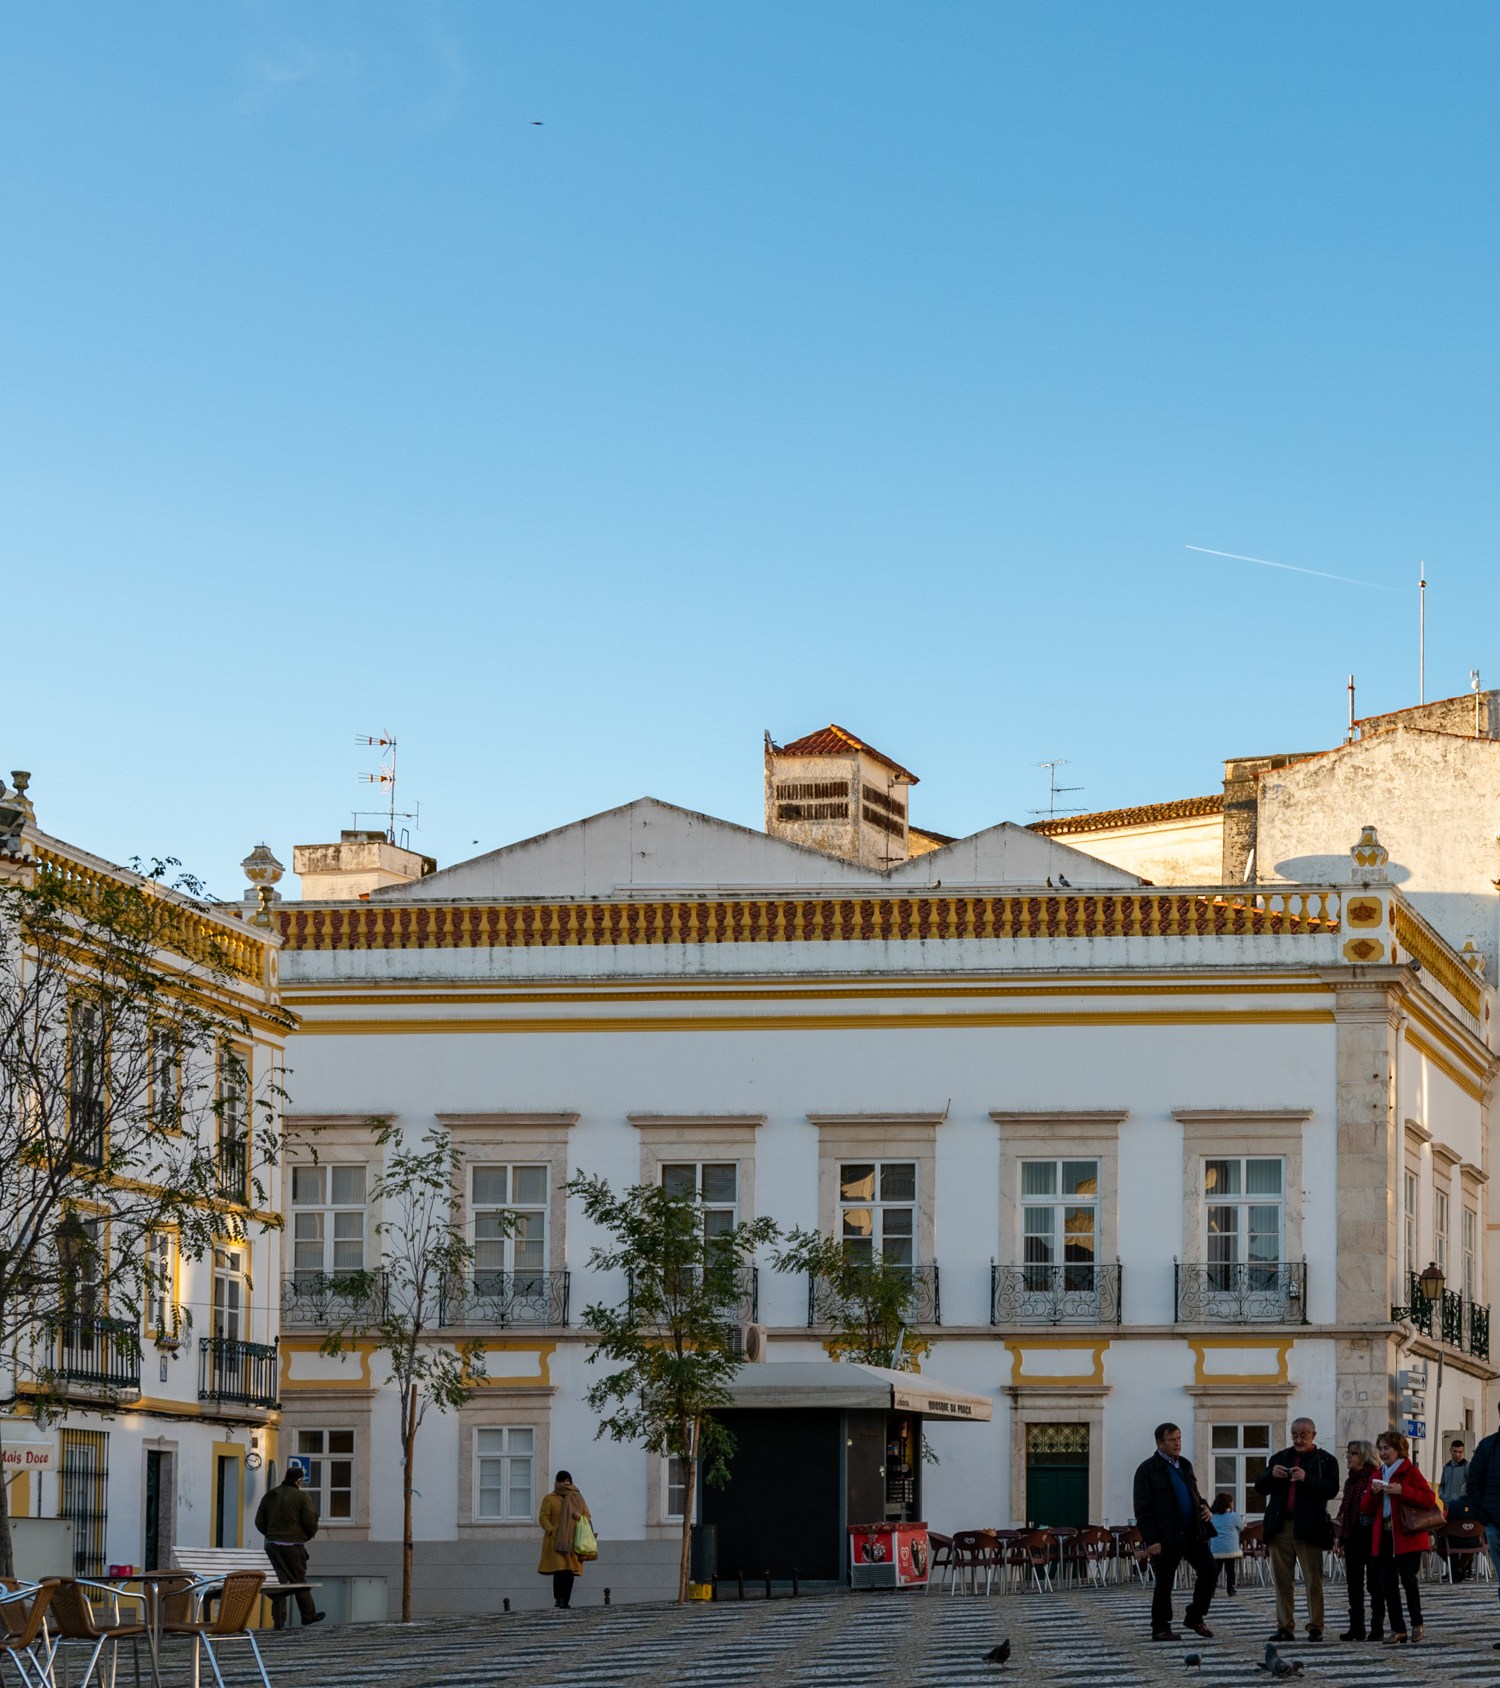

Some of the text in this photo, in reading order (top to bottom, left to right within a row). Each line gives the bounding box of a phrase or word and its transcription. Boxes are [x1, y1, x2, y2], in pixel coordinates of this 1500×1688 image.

[928, 1400, 949, 1412] QUIOSQUE
[950, 1403, 956, 1412] DA
[25, 1450, 49, 1465] Doce
